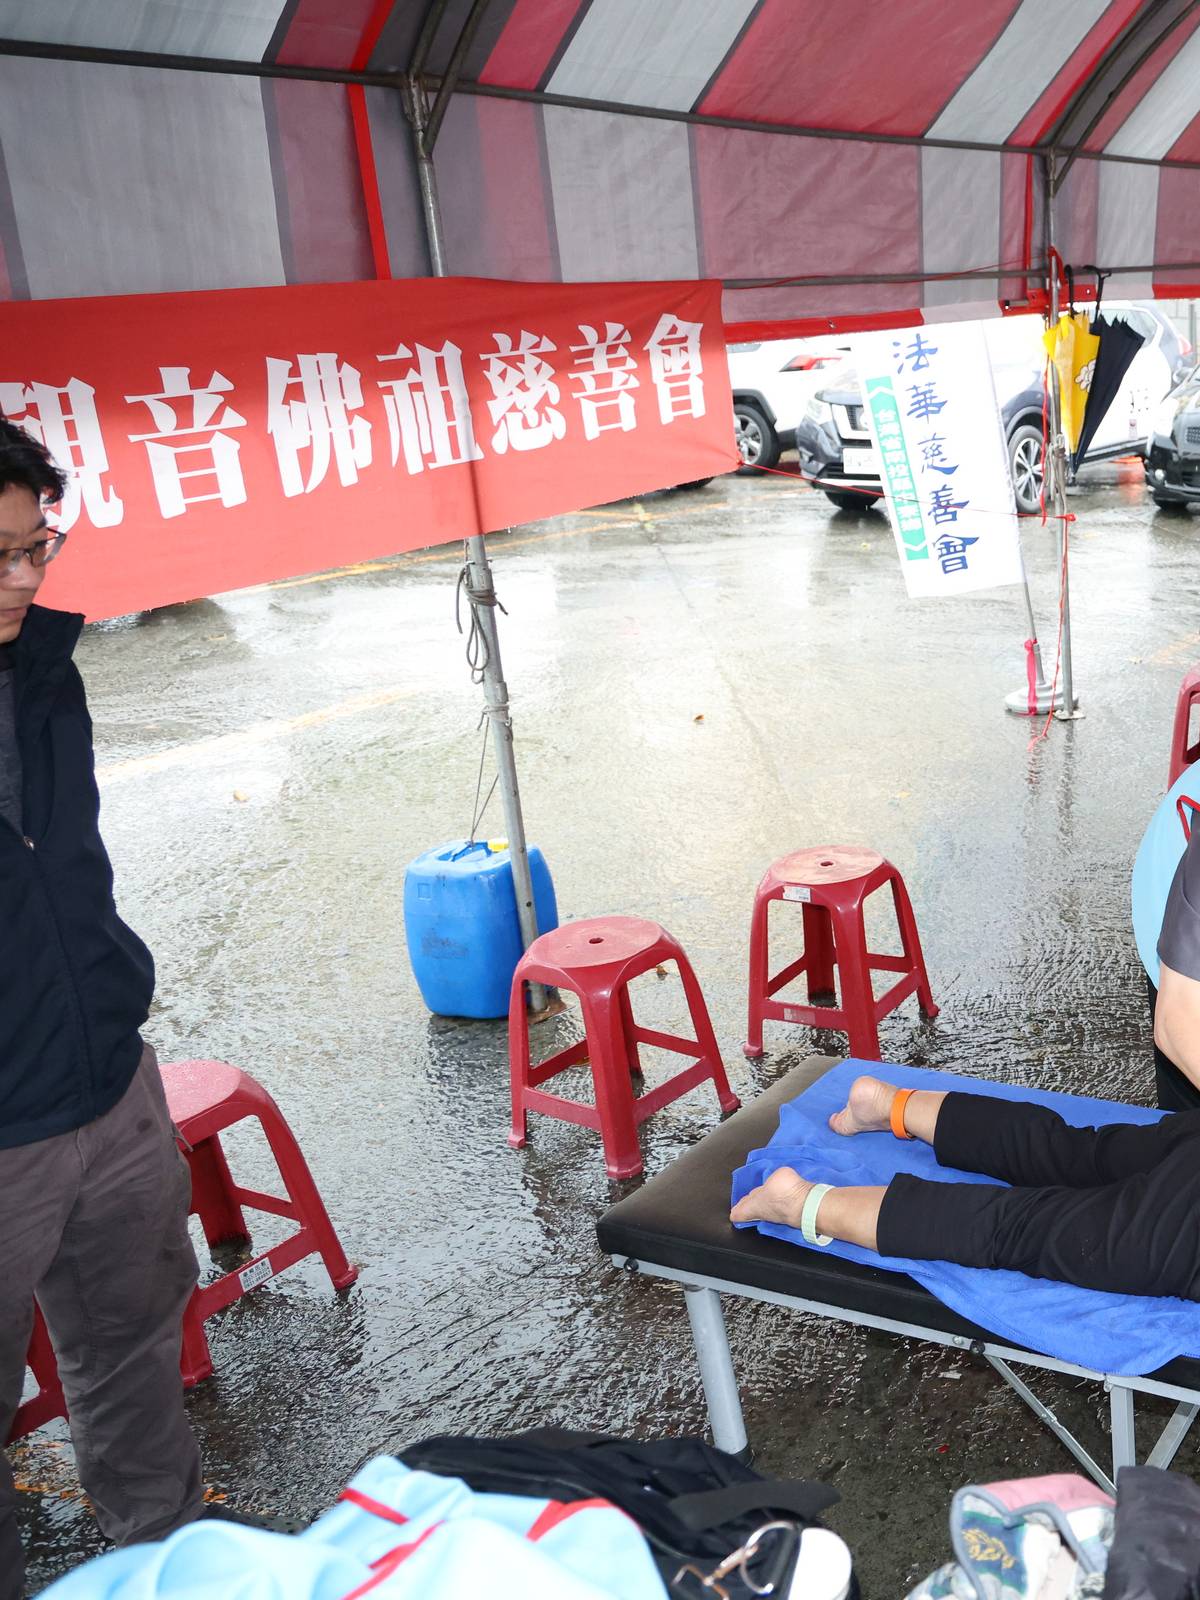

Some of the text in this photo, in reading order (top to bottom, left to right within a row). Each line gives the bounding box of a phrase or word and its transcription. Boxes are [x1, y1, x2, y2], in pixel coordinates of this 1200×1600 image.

[893, 333, 980, 574] 法華慈善會
